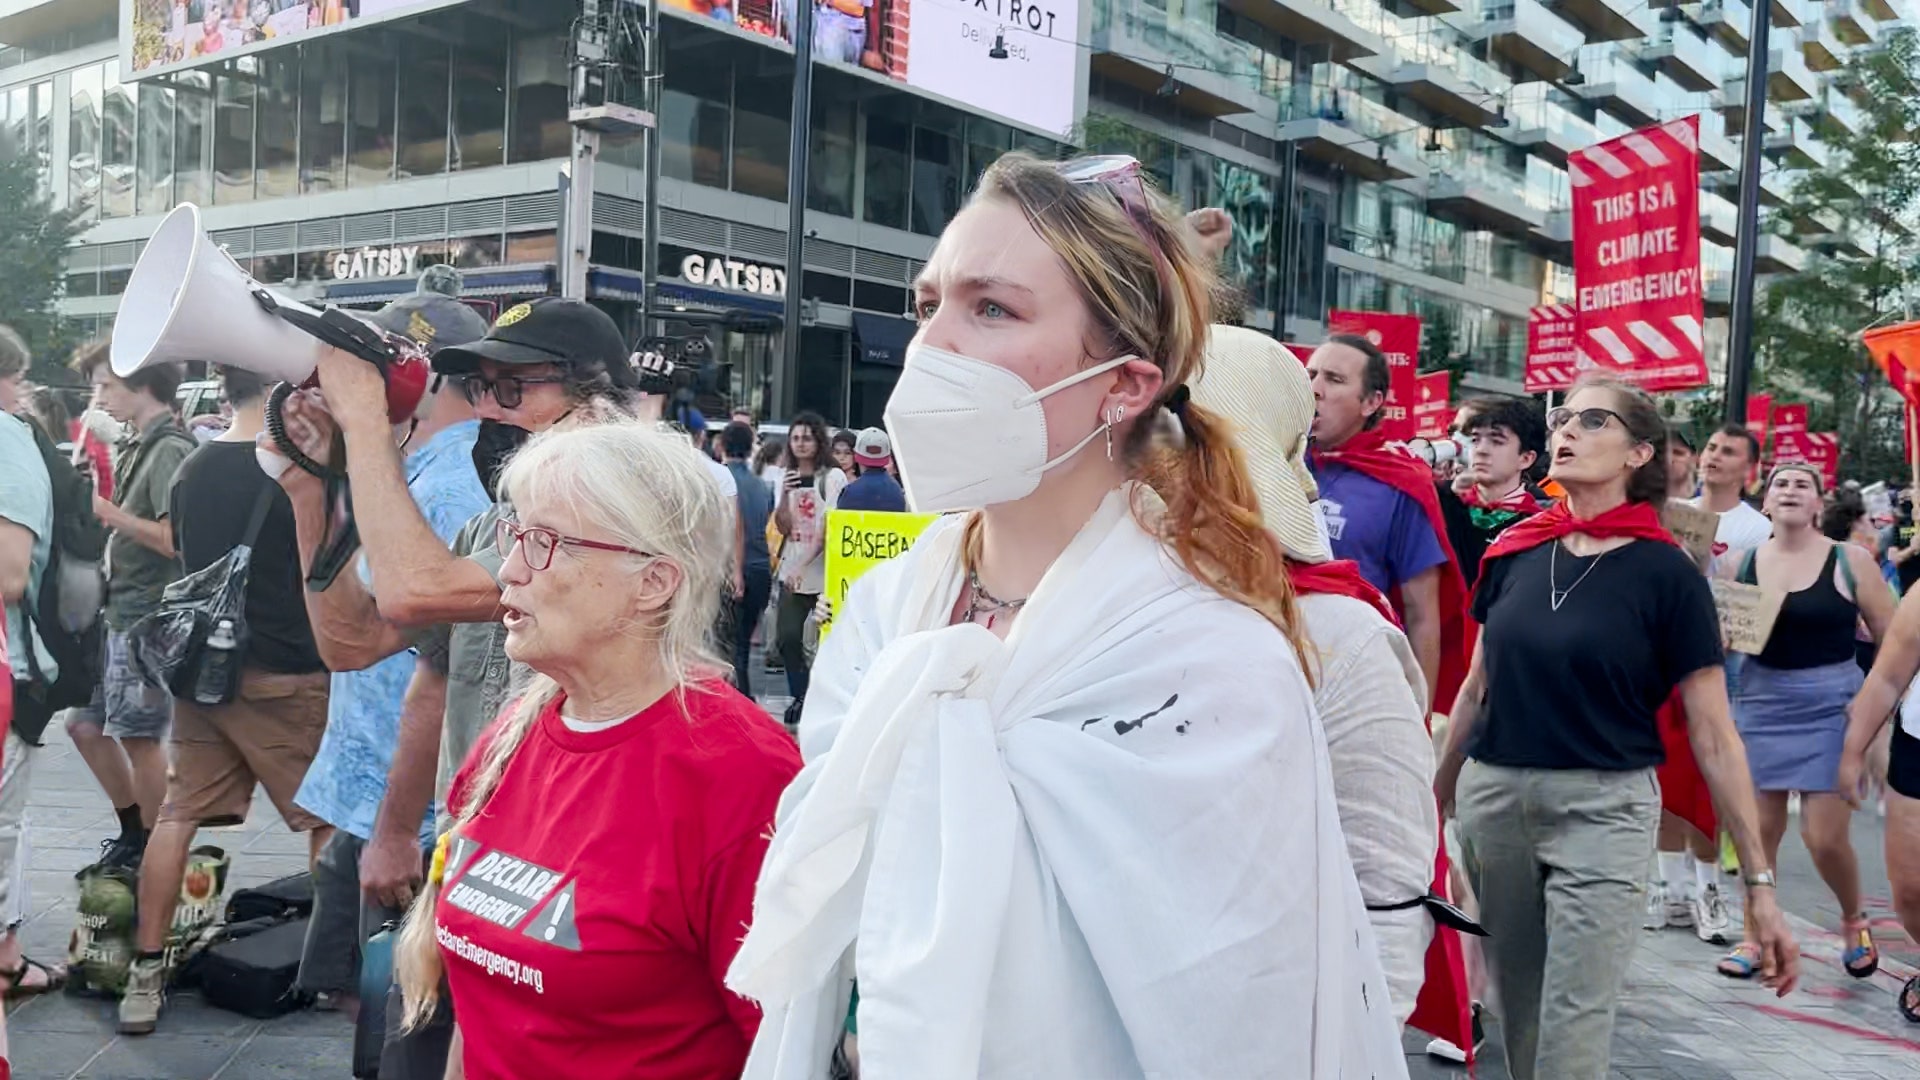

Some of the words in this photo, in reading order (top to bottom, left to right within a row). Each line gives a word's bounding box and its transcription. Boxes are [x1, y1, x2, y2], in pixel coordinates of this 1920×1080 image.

[1592, 192, 1635, 224] THIS
[1638, 185, 1660, 214] IS
[1661, 181, 1677, 208] A
[333, 246, 419, 280] GATSBY
[1598, 226, 1679, 267] CLIMATE
[1580, 265, 1699, 312] EMERGENCY
[841, 525, 916, 559] BASEBA
[467, 851, 563, 901] DECLARE
[446, 883, 528, 928] EMERGENCY
